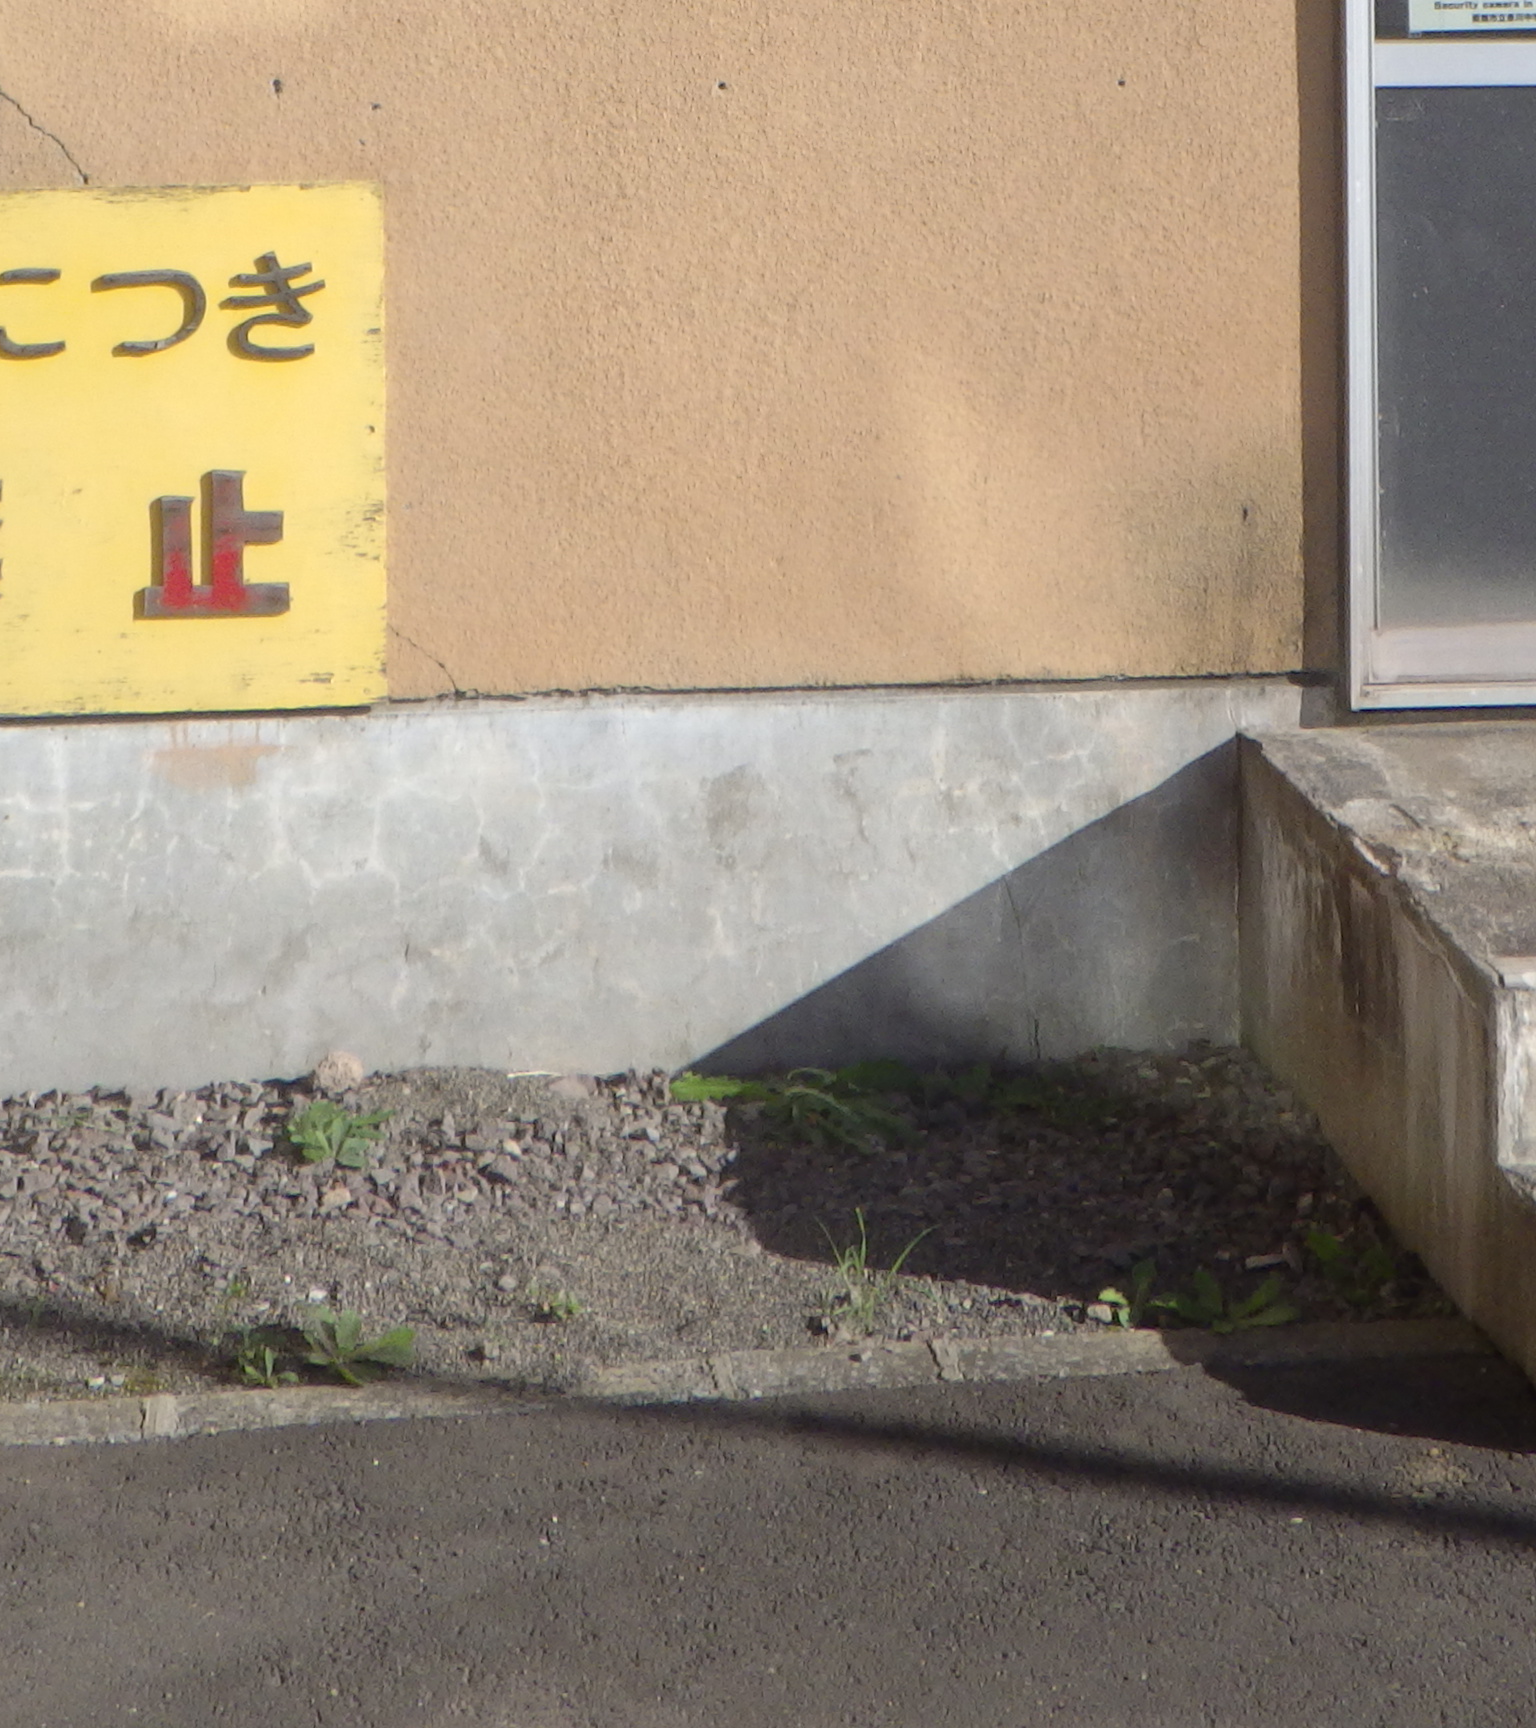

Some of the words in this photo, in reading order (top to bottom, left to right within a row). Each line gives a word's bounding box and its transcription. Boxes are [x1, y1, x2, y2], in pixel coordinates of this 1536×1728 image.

[1434, 1, 1478, 10] Security
[1483, 1, 1519, 9] camera
[1524, 0, 1533, 8] in
